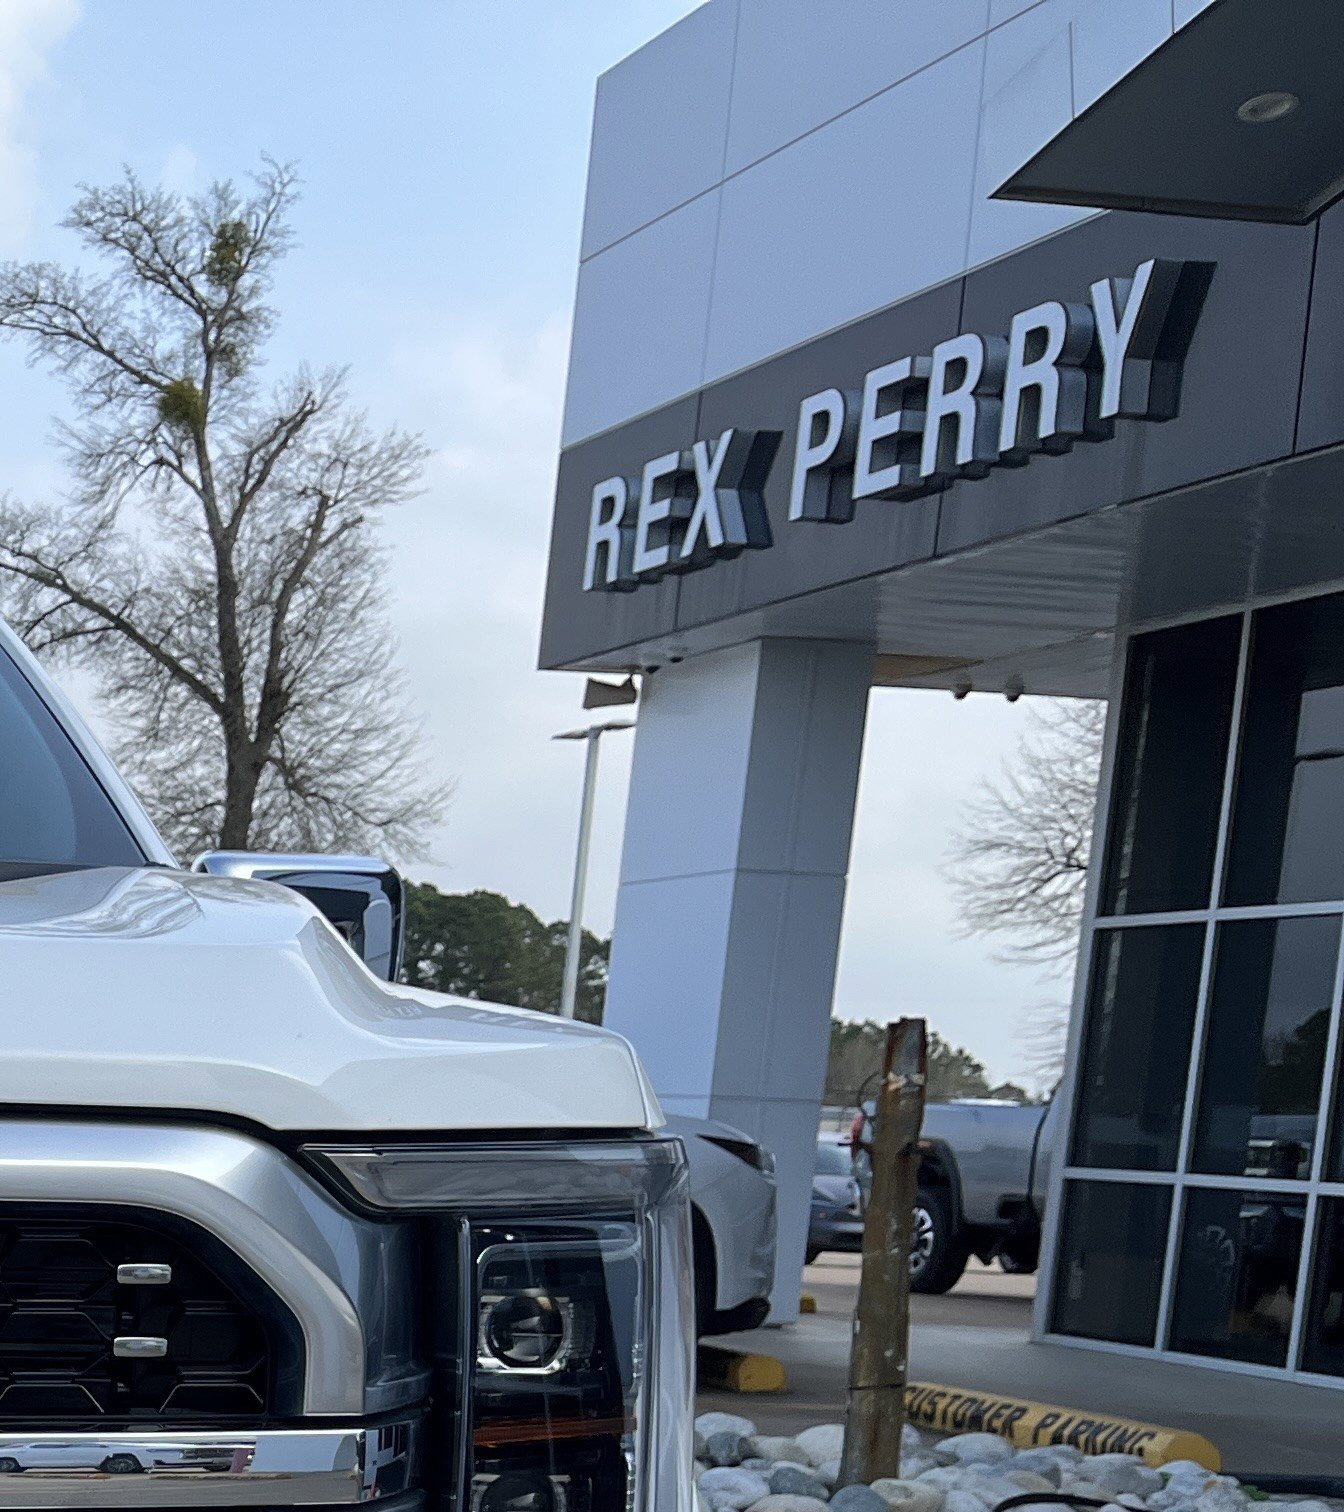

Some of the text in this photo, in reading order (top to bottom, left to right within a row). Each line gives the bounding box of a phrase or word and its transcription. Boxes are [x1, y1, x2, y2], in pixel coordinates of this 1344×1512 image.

[582, 258, 1160, 592] REX PERRY
[904, 1385, 1157, 1457] CUSTOMER PARKING
